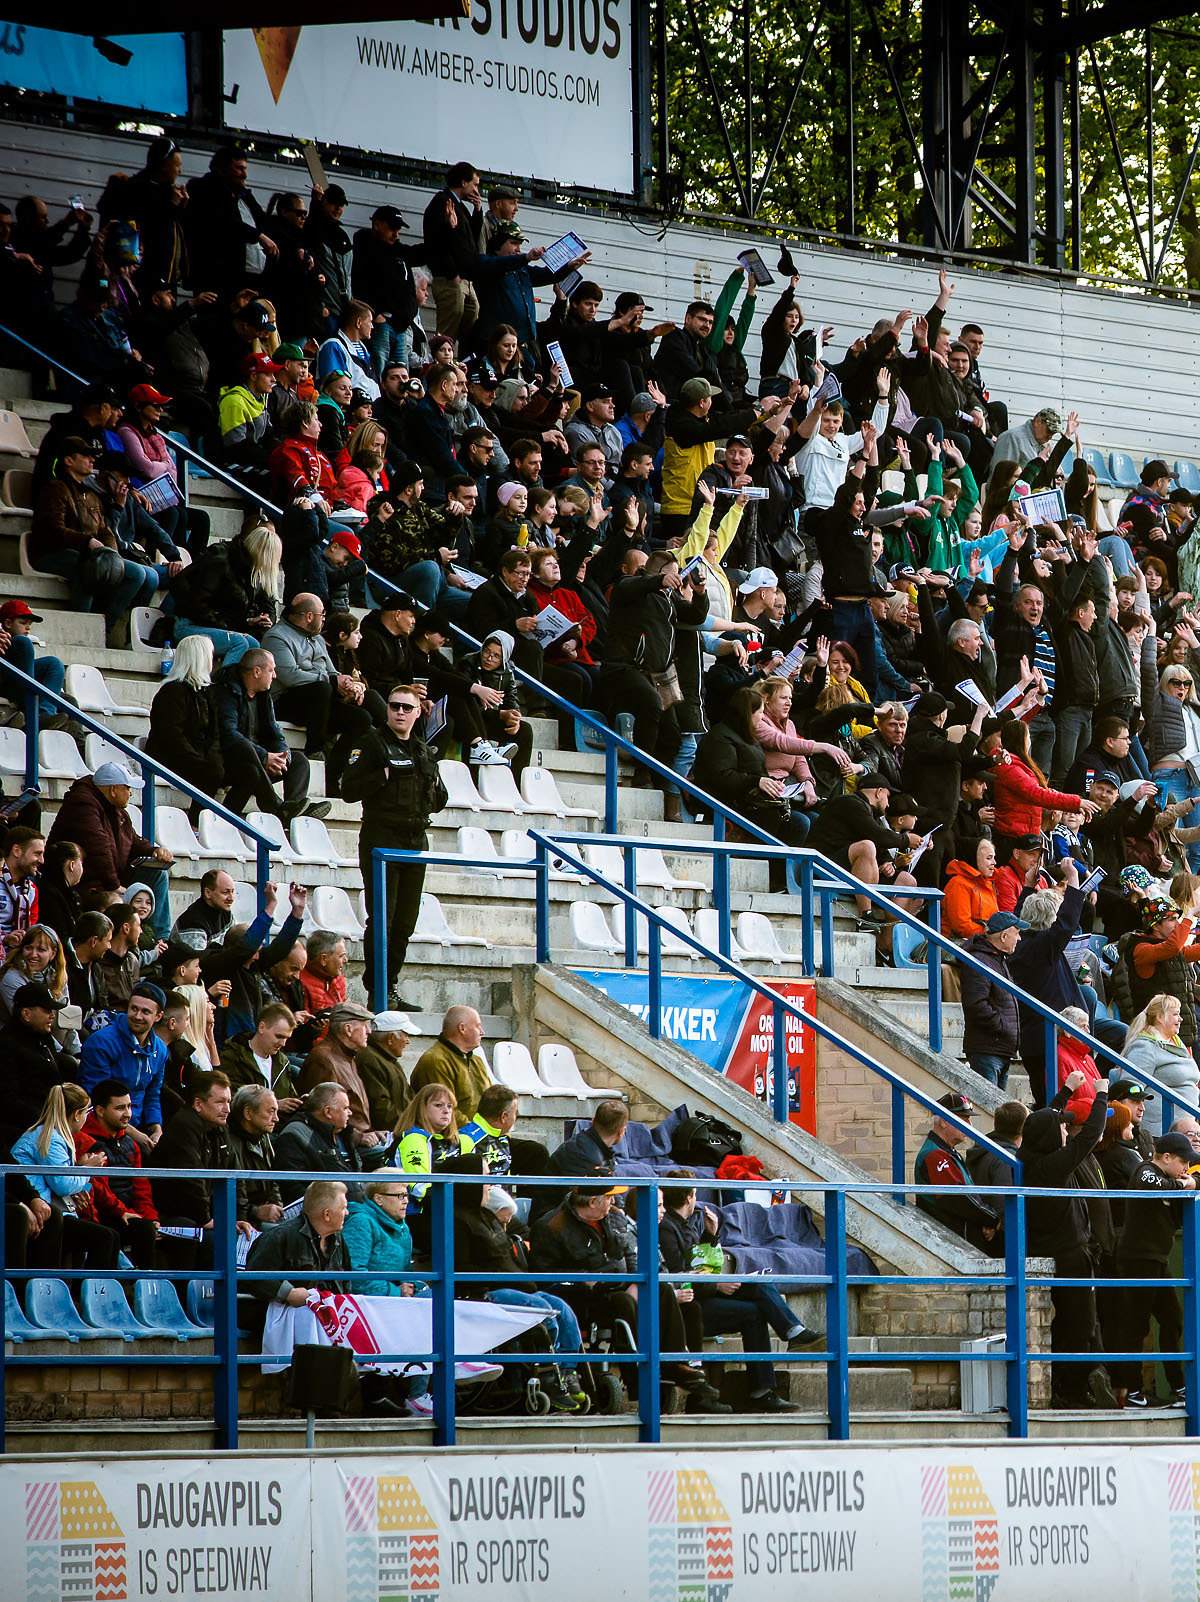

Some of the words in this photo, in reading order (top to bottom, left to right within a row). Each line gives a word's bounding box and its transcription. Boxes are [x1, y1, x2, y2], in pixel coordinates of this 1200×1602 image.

[356, 35, 600, 107] WWW.AMBER-STUDIOS.COM
[537, 751, 543, 767] 9
[643, 823, 649, 838] 8
[750, 1034, 774, 1053] MOT
[788, 1035, 804, 1054] OIL
[759, 1014, 804, 1034] ORNAL
[136, 1480, 283, 1529] DAUGAVPILS
[448, 1474, 586, 1522] DAUGAVPILS
[740, 1469, 865, 1515] DAUGAVPILS
[1005, 1465, 1118, 1508] DAUGAVPILS
[450, 1540, 470, 1585] IR
[476, 1538, 550, 1584] SPORTS
[742, 1533, 760, 1575] IS
[765, 1530, 857, 1574] SPEEDWAY
[1007, 1526, 1024, 1566] IR
[1028, 1524, 1090, 1566] SPORTS
[138, 1549, 158, 1595] IS
[166, 1545, 273, 1593] SPEEDWAY
